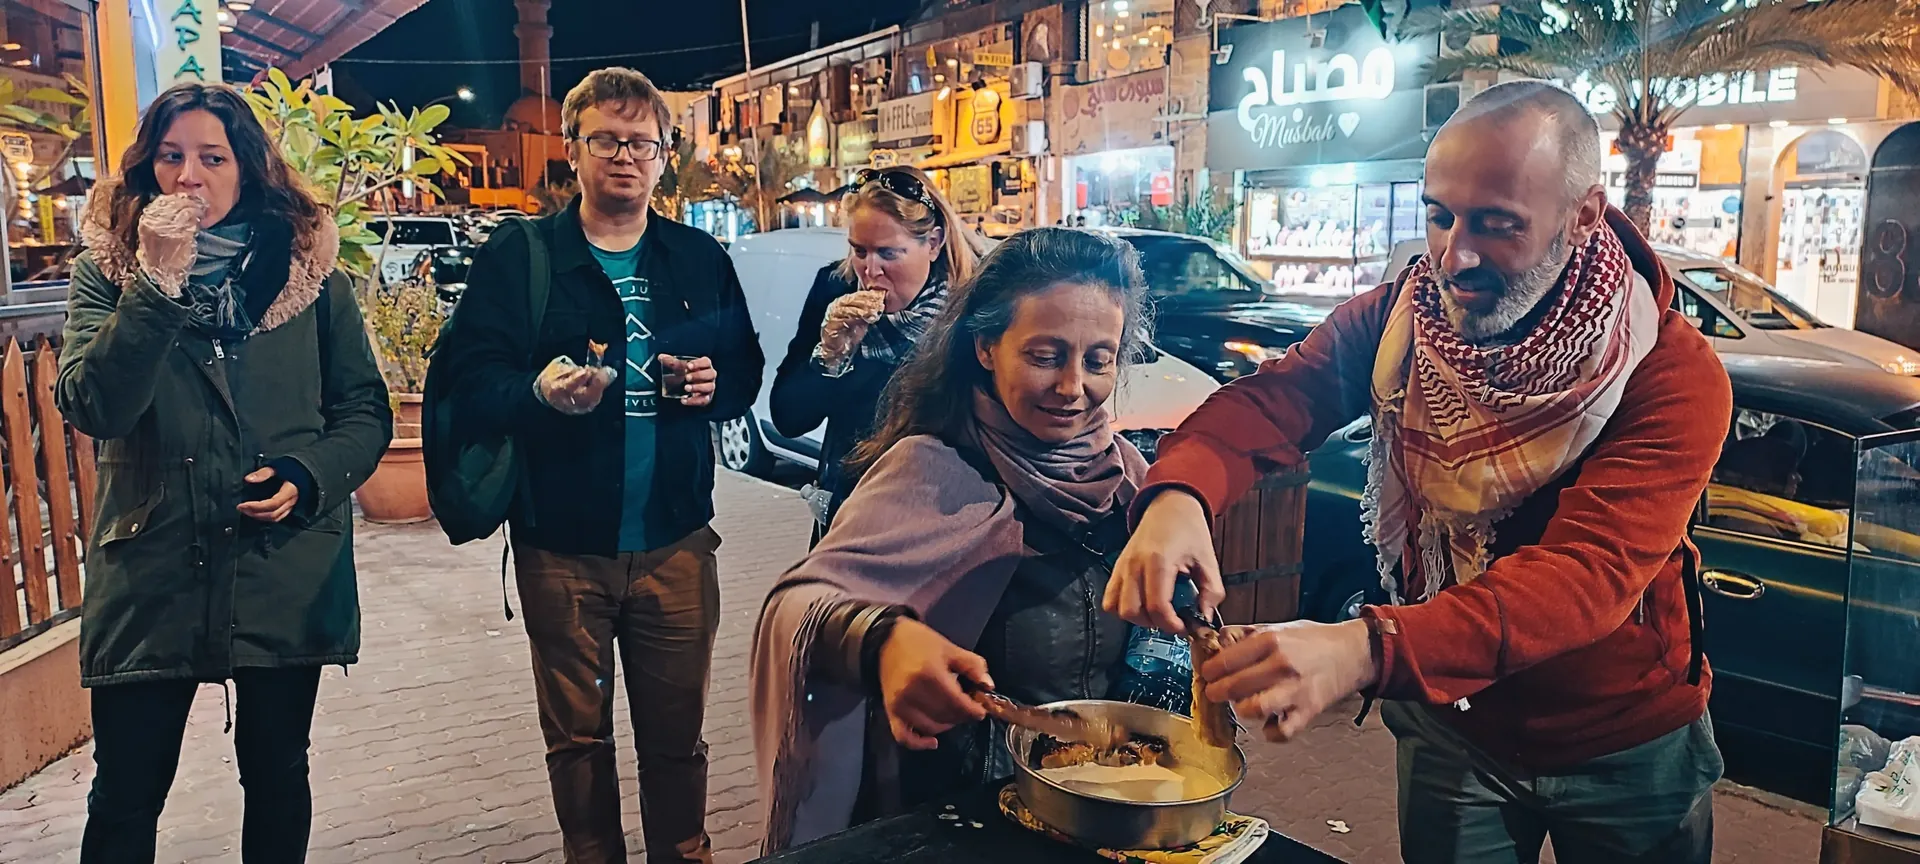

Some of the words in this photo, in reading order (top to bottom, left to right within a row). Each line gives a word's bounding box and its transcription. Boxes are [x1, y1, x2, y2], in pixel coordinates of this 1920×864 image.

[1238, 47, 1395, 132] مصباح
[977, 116, 993, 135] 65
[1251, 112, 1336, 149] Musbah
